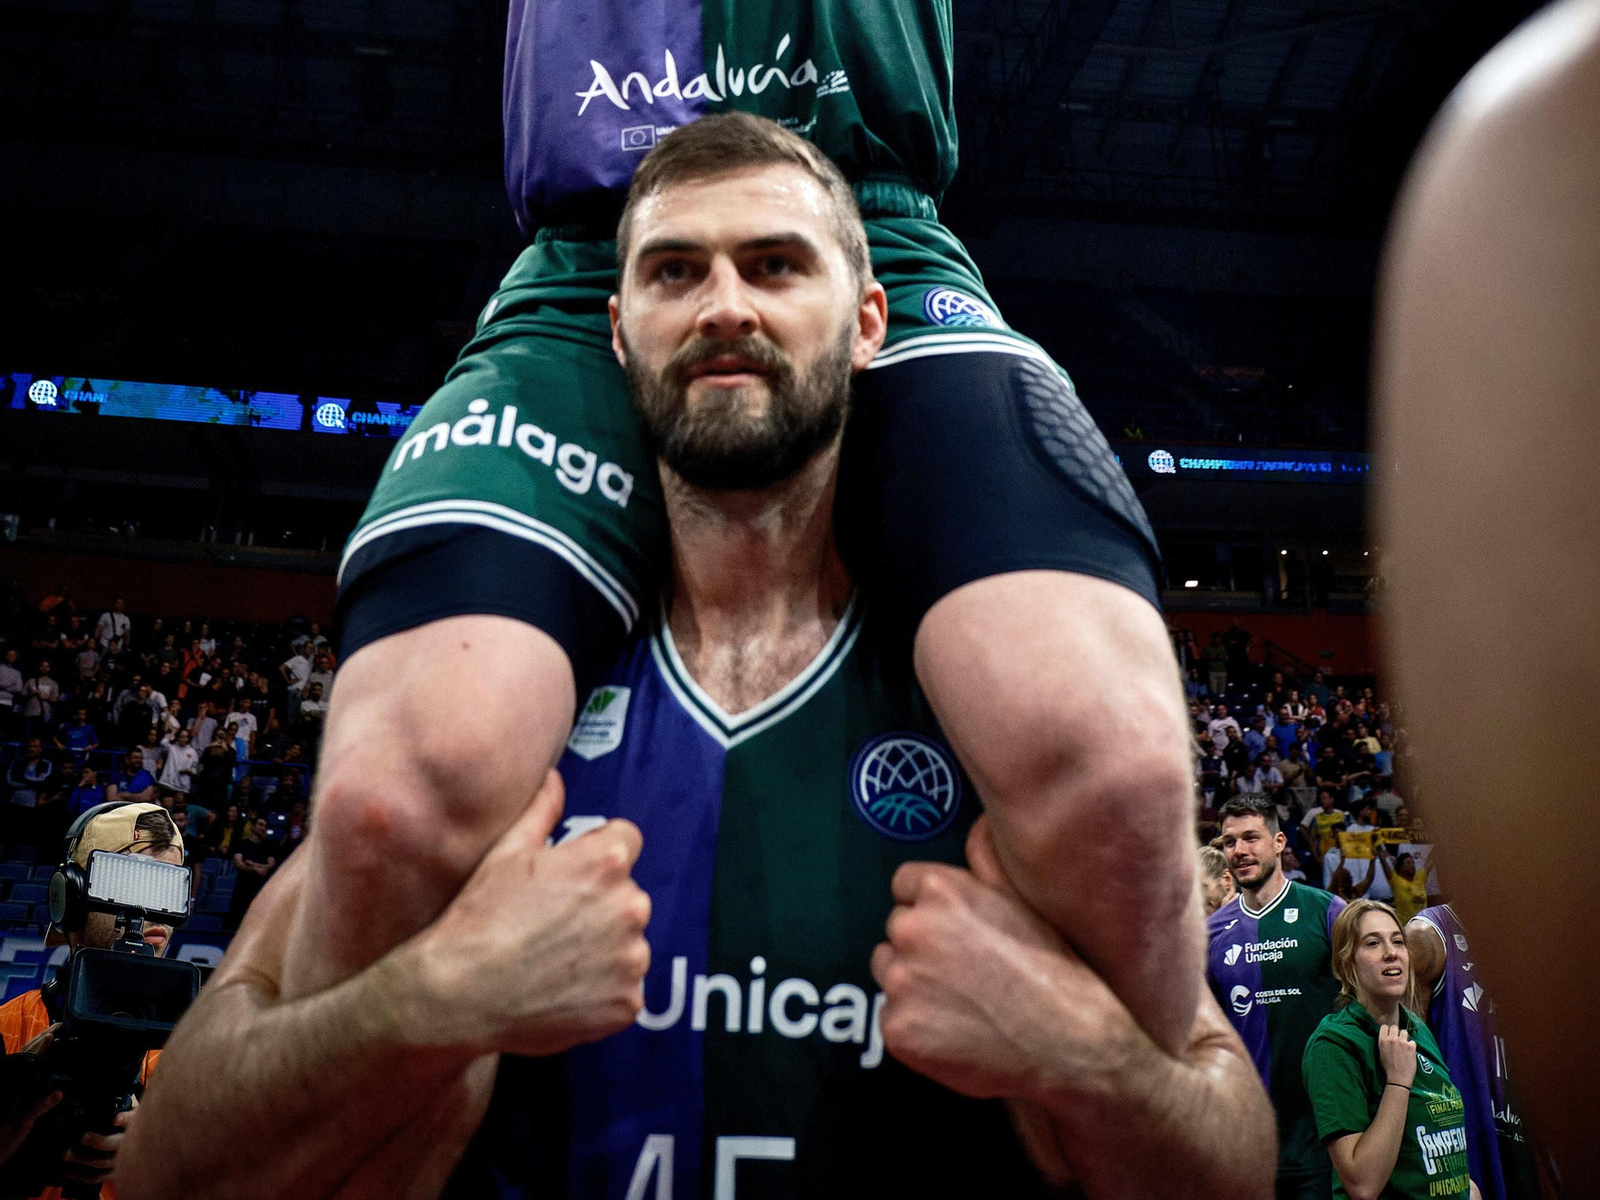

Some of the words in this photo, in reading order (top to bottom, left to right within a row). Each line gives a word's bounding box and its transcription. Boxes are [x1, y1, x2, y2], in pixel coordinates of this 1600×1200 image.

[576, 33, 818, 117] Andalucía
[1244, 937, 1299, 953] Fundación
[1245, 949, 1284, 963] Unicaja
[1254, 990, 1275, 998] COSTA
[1274, 988, 1287, 996] DEL
[1287, 987, 1302, 995] SOL
[1429, 1101, 1451, 1115] FINAL
